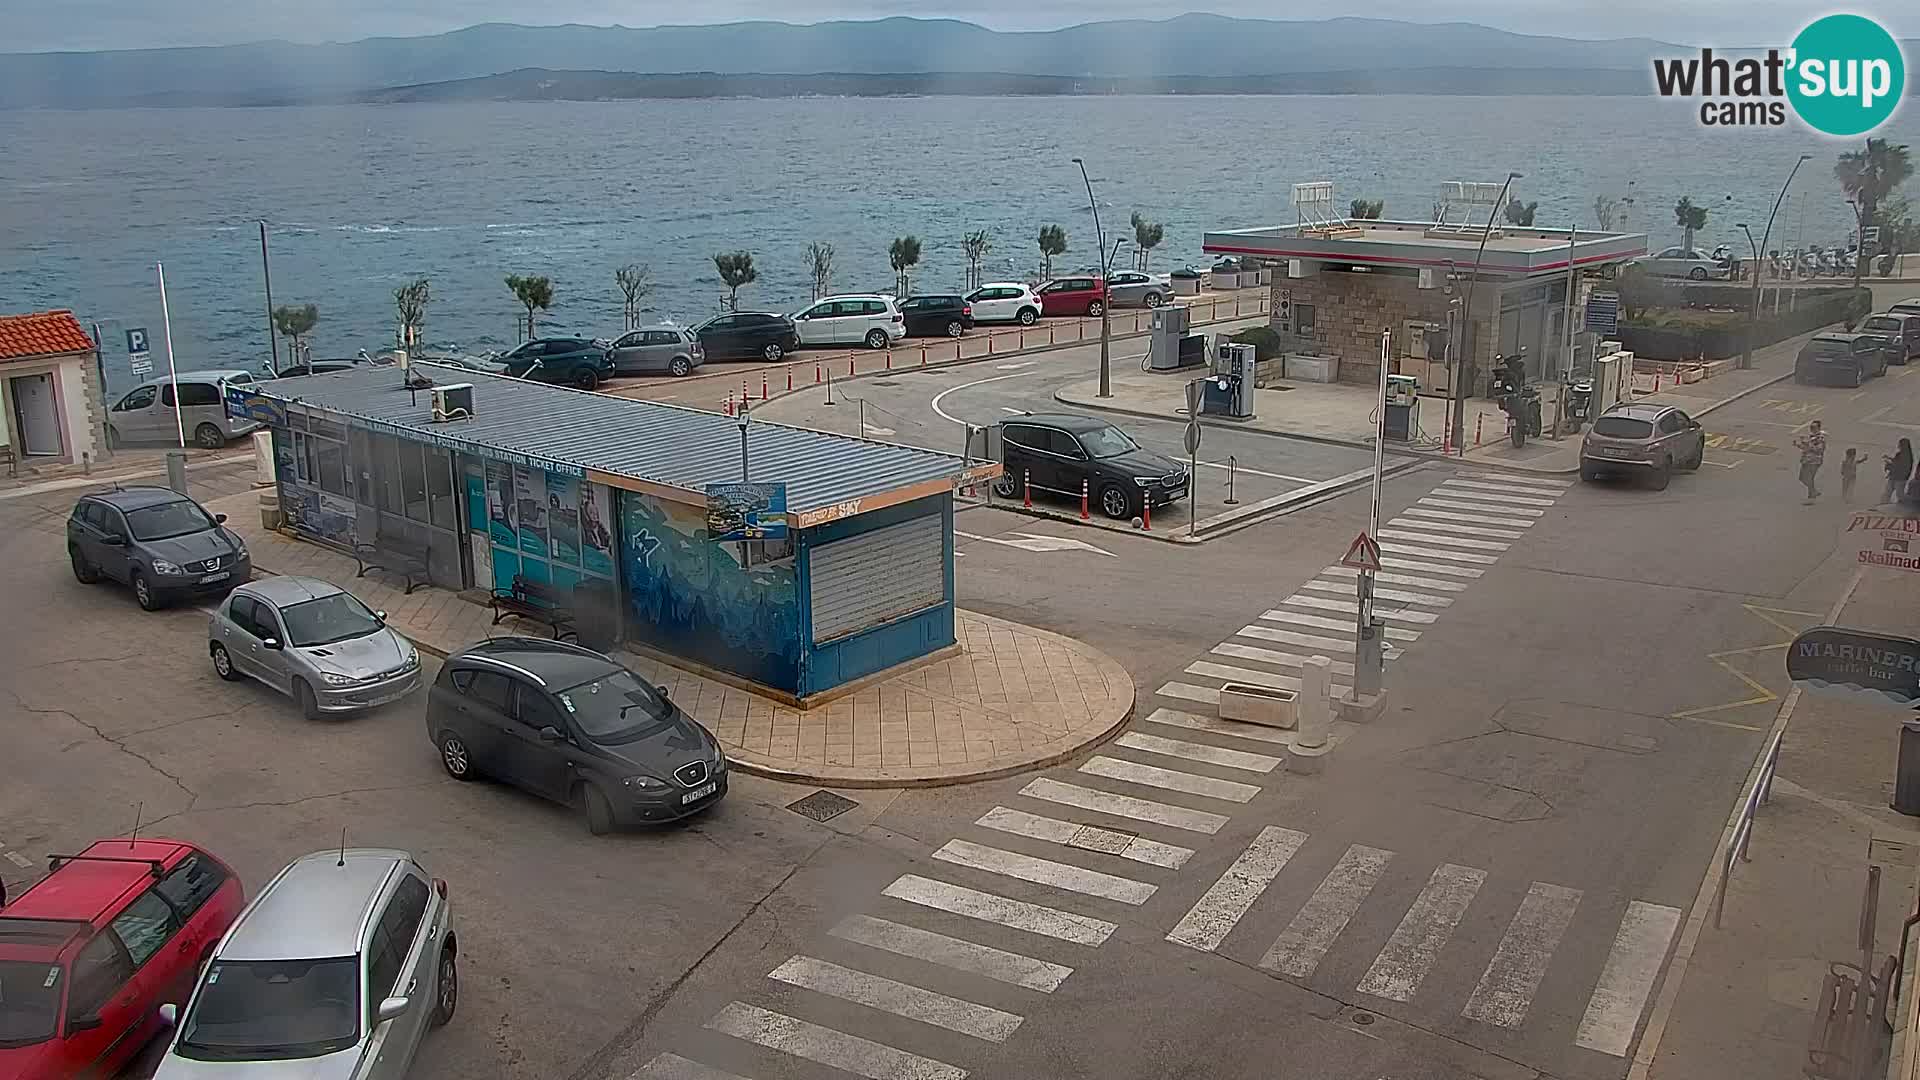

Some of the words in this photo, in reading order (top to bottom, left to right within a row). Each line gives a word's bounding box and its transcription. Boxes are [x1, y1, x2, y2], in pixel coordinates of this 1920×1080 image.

[131, 331, 144, 350] P
[437, 437, 468, 451] POSTAJA
[478, 447, 493, 458] BUS
[494, 450, 527, 465] STATION
[529, 457, 555, 471] TICKET
[555, 463, 583, 477] OFFICE
[1869, 666, 1895, 680] bar
